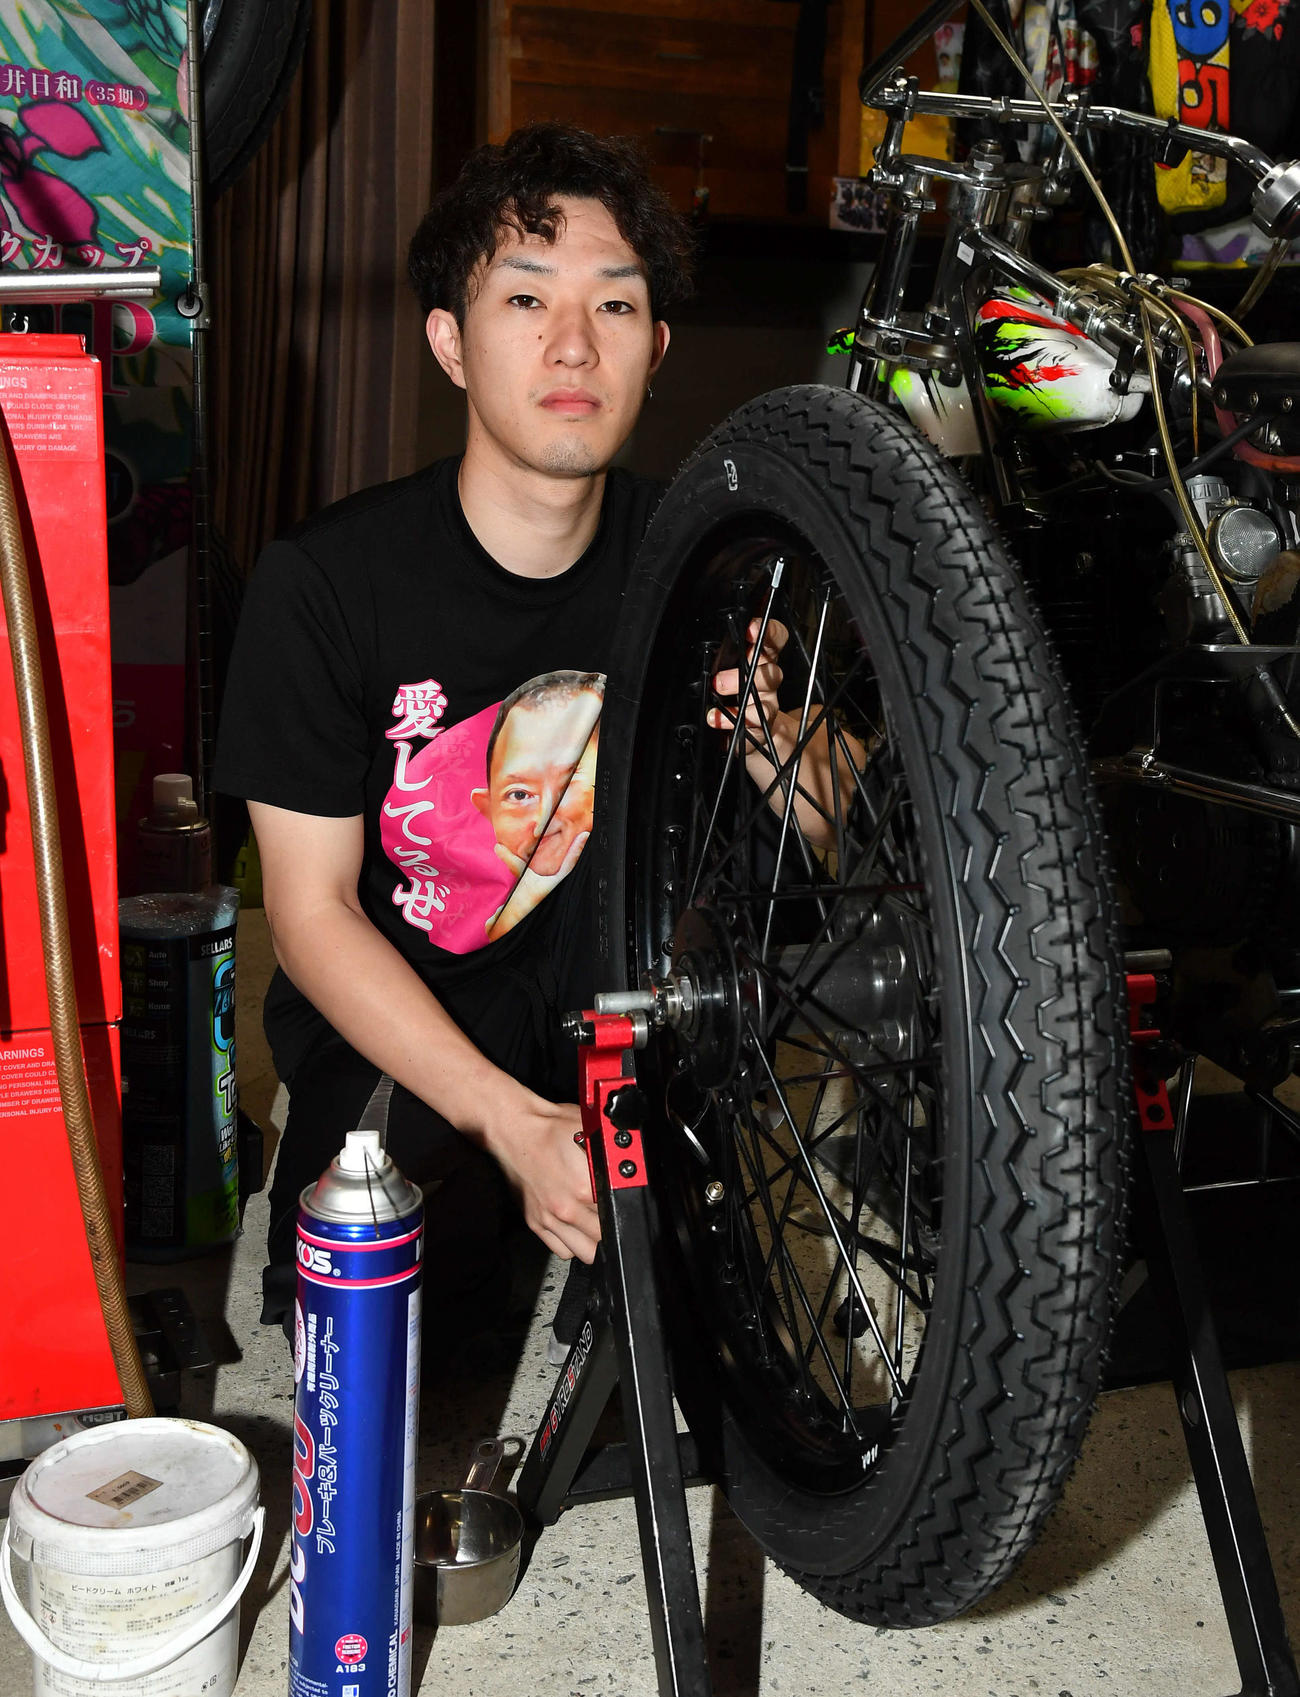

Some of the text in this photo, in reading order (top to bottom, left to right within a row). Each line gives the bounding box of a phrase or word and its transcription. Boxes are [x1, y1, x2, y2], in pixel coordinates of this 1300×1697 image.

[384, 679, 451, 932] 愛してるぜ
[200, 937, 233, 956] SELLARS
[9, 1081, 42, 1089] PERSONAL
[71, 1585, 121, 1595] ビードクリーム
[127, 1584, 158, 1594] ホワイト
[387, 1629, 398, 1687] CHEMICAL
